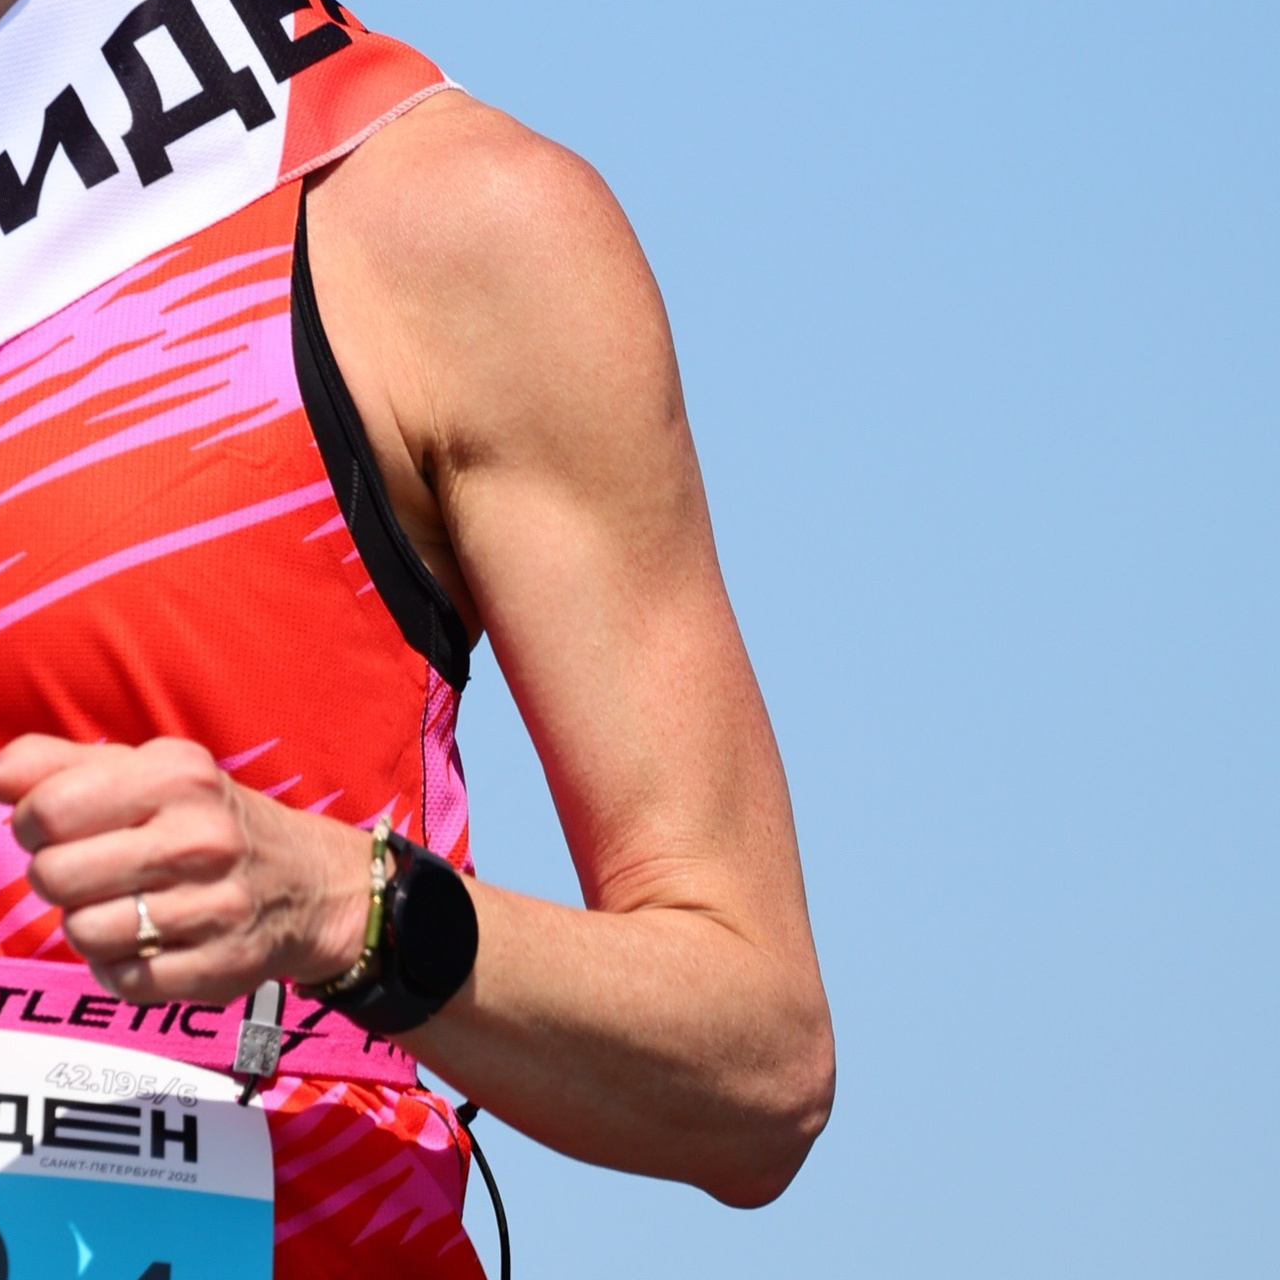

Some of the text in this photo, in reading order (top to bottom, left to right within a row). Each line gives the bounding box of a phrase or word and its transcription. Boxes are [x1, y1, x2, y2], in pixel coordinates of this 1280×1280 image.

[45, 1062, 198, 1108] 42.195/6
[39, 1156, 198, 1184] САНКТ-ПЕТЕРБУРГ 2025
